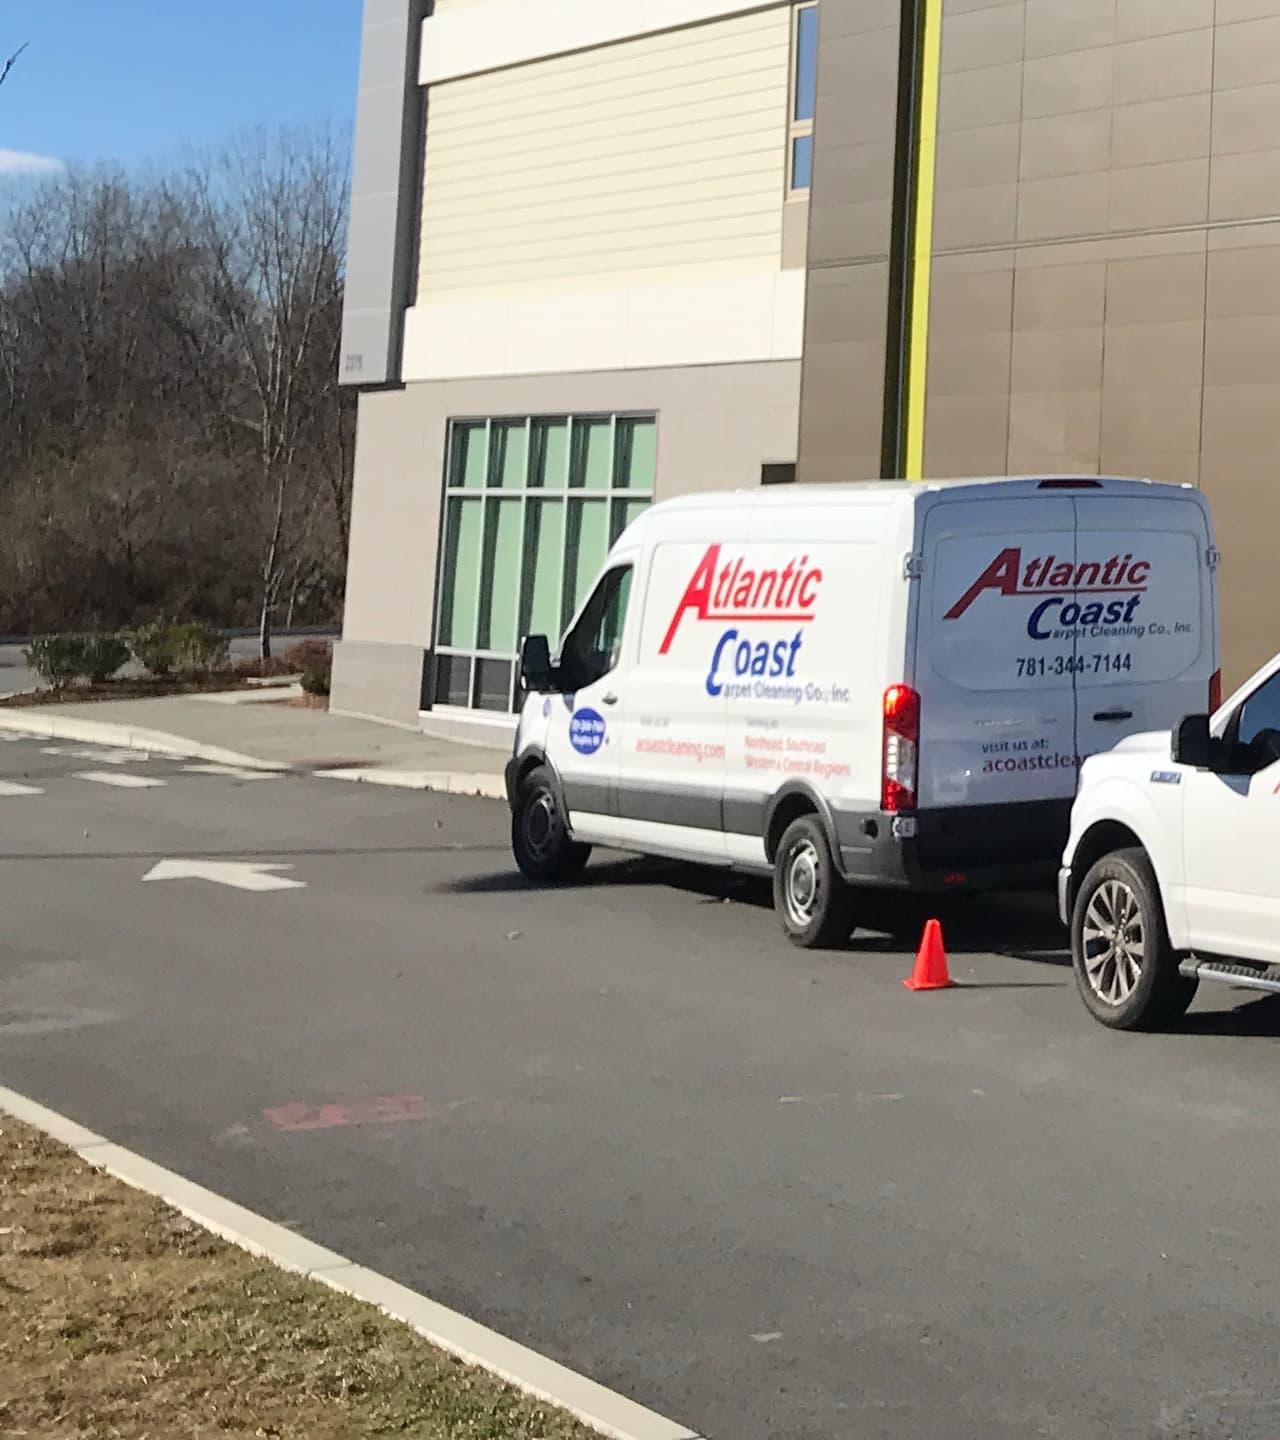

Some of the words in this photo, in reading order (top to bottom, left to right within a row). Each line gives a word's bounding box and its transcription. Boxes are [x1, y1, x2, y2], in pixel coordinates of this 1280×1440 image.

[658, 543, 823, 654] Atlantic
[942, 548, 1151, 620] Atlantic
[1027, 594, 1141, 640] Coast
[1090, 624, 1145, 638] Cleaning
[706, 628, 804, 696] Coast
[1016, 653, 1132, 677] 781-344-7144
[754, 680, 802, 705] Cleaning
[982, 739, 1008, 753] visit
[1013, 741, 1028, 752] us
